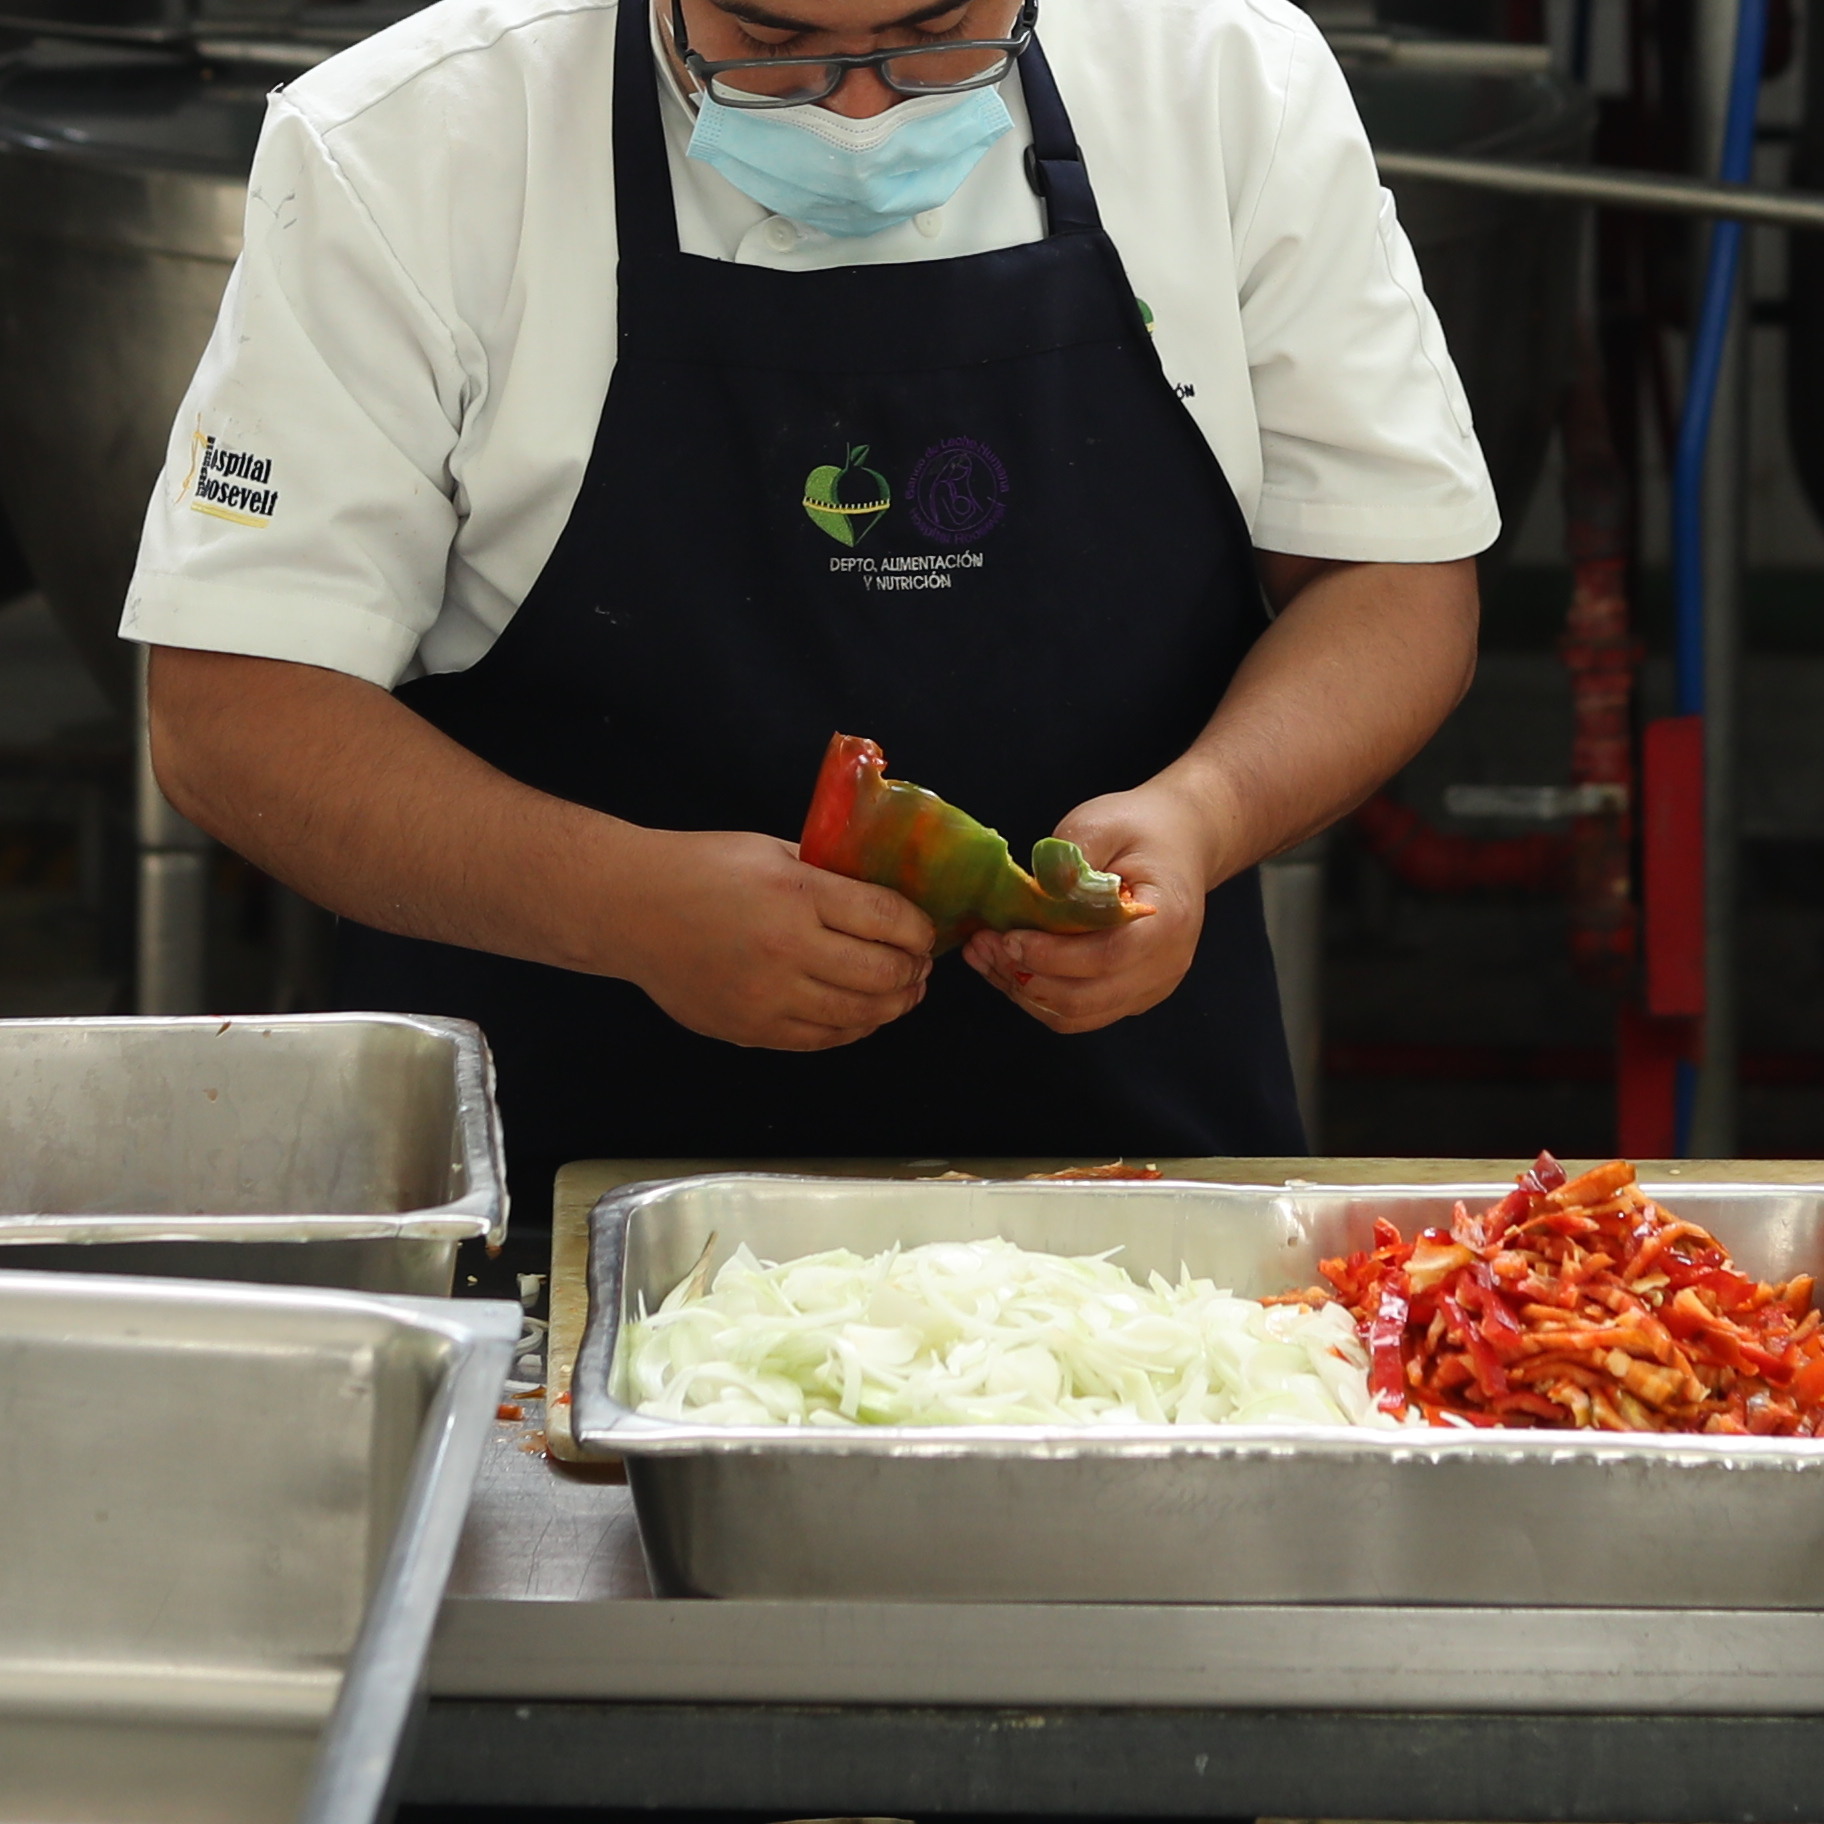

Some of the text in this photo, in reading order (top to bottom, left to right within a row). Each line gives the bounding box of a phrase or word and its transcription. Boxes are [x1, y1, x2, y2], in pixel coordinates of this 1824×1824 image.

[210, 448, 271, 484] ospital
[905, 458, 926, 500] Banco
[977, 442, 1010, 492] Humana
[206, 479, 278, 516] osevelt
[881, 550, 984, 572] ALIMENTACIÓN
[863, 571, 952, 591] Y NUTRICIÓN
